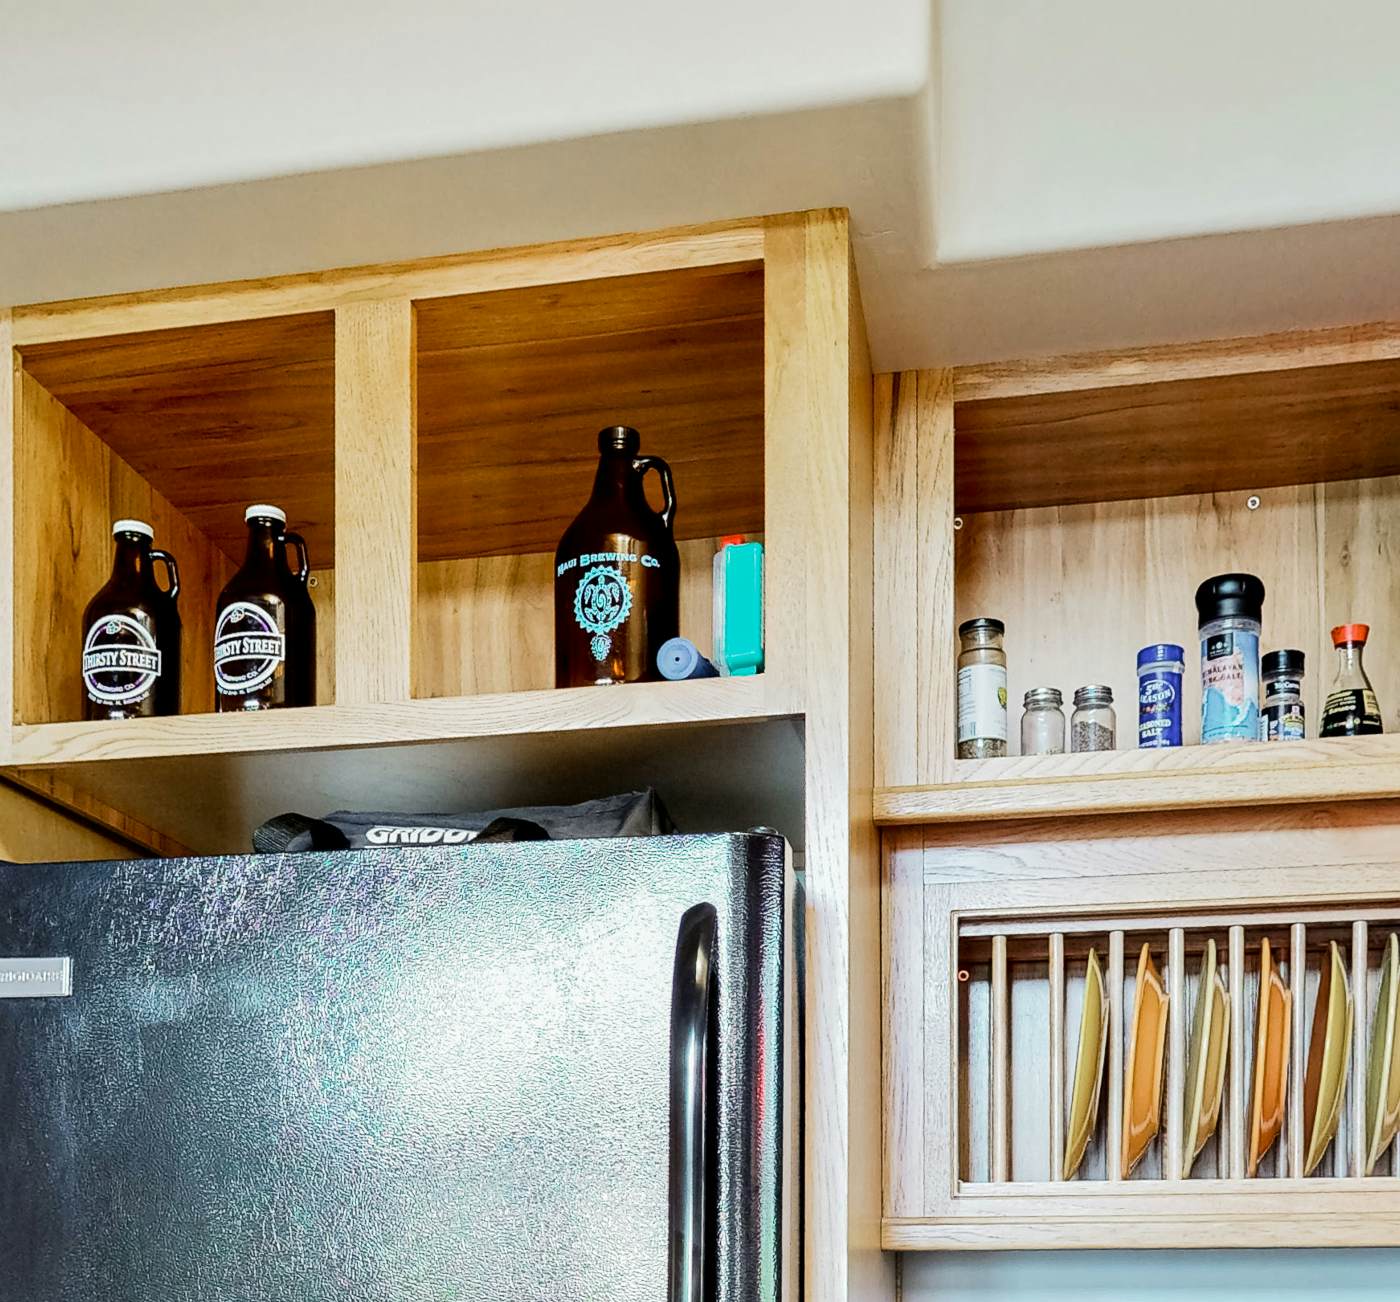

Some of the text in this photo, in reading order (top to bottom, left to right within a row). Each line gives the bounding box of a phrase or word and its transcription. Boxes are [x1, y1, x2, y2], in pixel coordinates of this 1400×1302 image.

[557, 558, 577, 577] MAUI
[580, 552, 638, 567] BREWING
[242, 637, 281, 655] STREET
[120, 650, 158, 670] STREET
[0, 971, 63, 982] RIGIDAIRE
